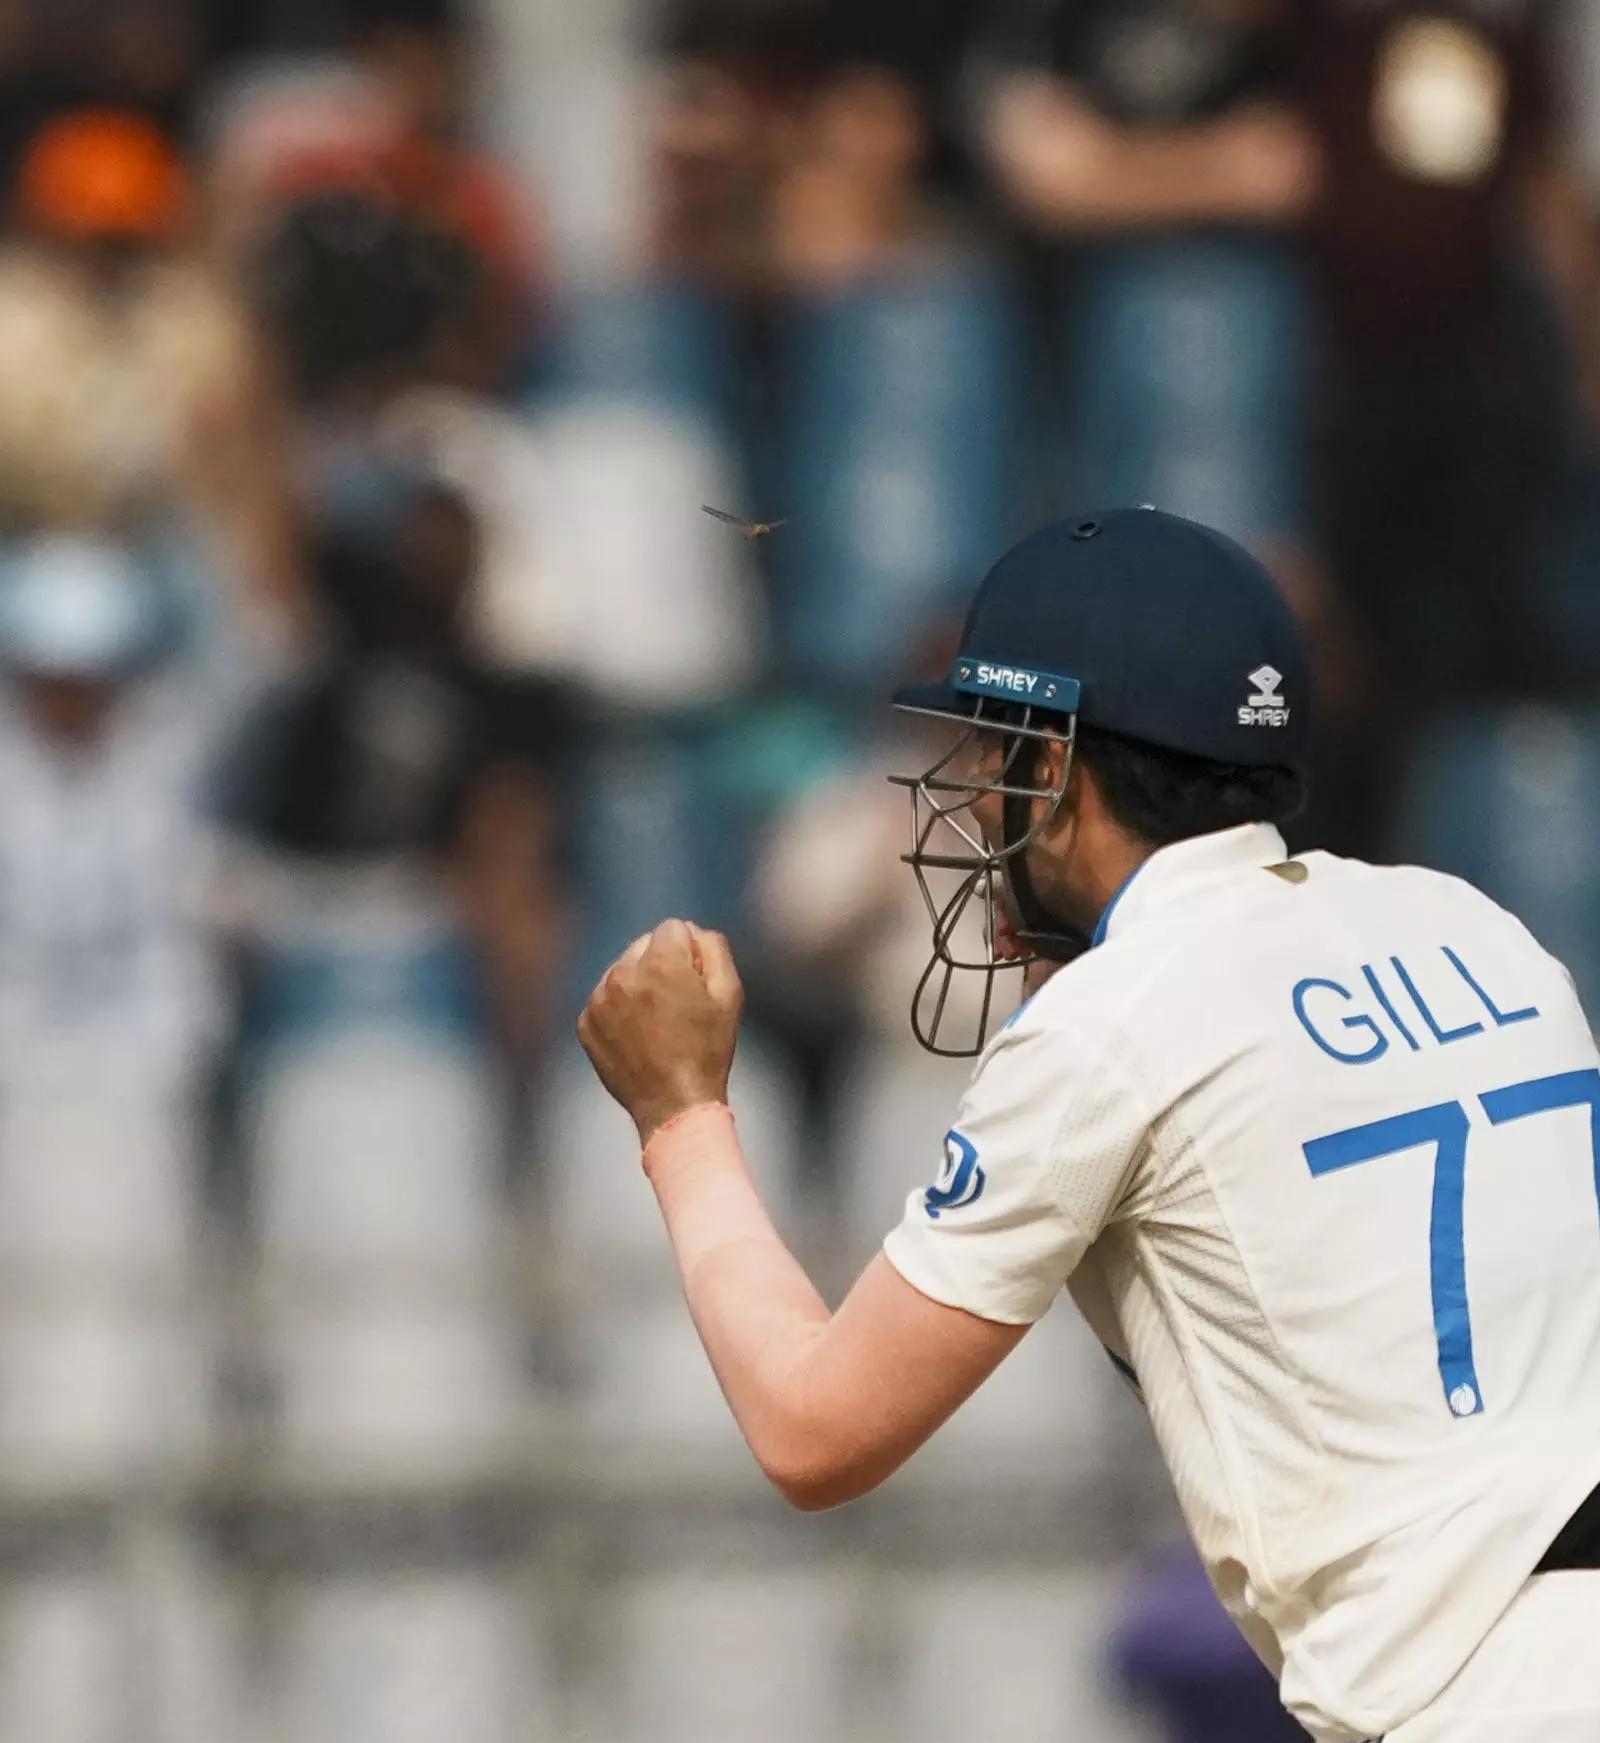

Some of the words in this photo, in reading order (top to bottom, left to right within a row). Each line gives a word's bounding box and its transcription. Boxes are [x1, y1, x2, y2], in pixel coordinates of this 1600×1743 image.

[977, 665, 1039, 693] SHREY
[1238, 707, 1290, 727] SHREY
[1292, 946, 1540, 1065] GILL
